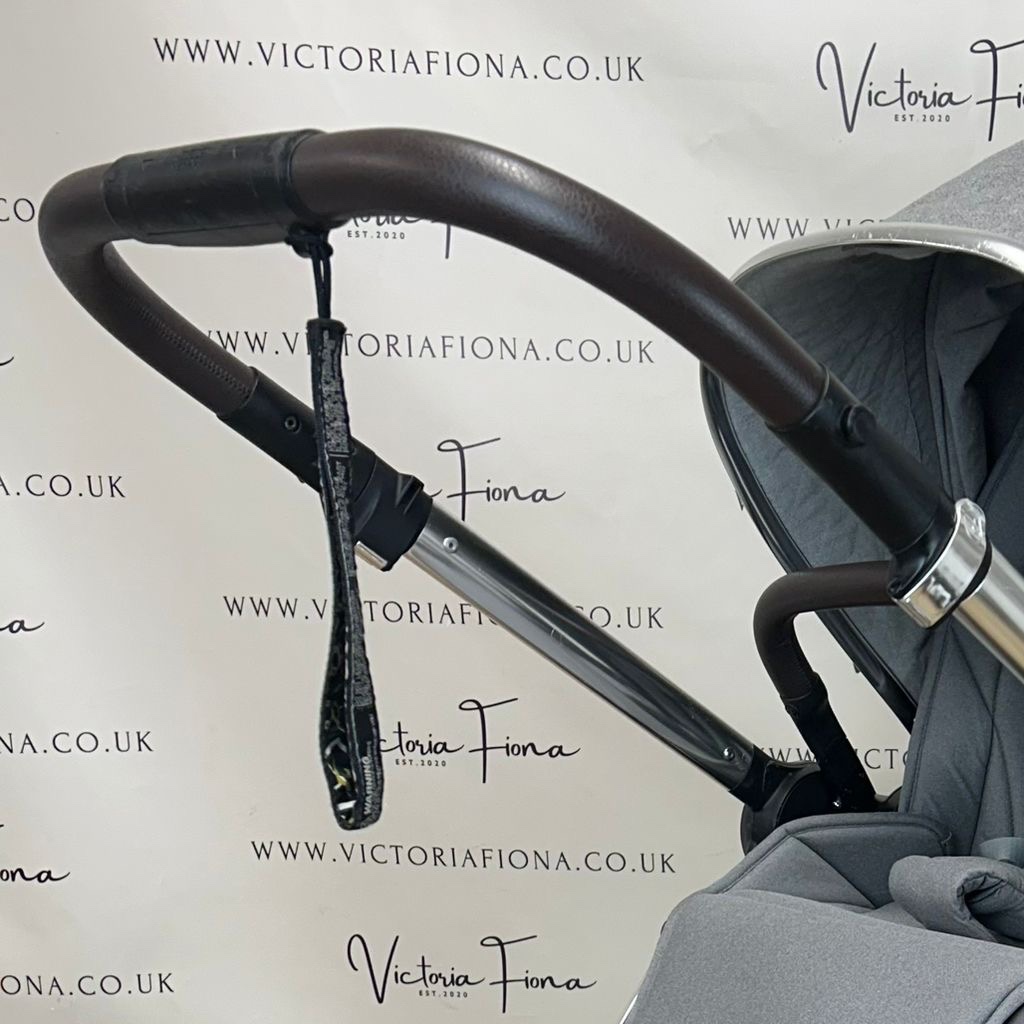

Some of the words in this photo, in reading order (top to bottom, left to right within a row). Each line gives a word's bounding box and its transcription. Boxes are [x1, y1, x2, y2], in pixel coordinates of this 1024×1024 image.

[153, 38, 644, 81] WWW.VICTORIAFIONA.CO.UK
[816, 41, 972, 133] Victoria
[893, 113, 951, 123] EST.2020
[436, 437, 567, 522] Fiona
[458, 698, 581, 784] Fiona
[251, 841, 675, 873] WWW.VICTORIAFIONA.CO.UK
[347, 934, 485, 1004] Victoria
[480, 935, 597, 1013] Fiona
